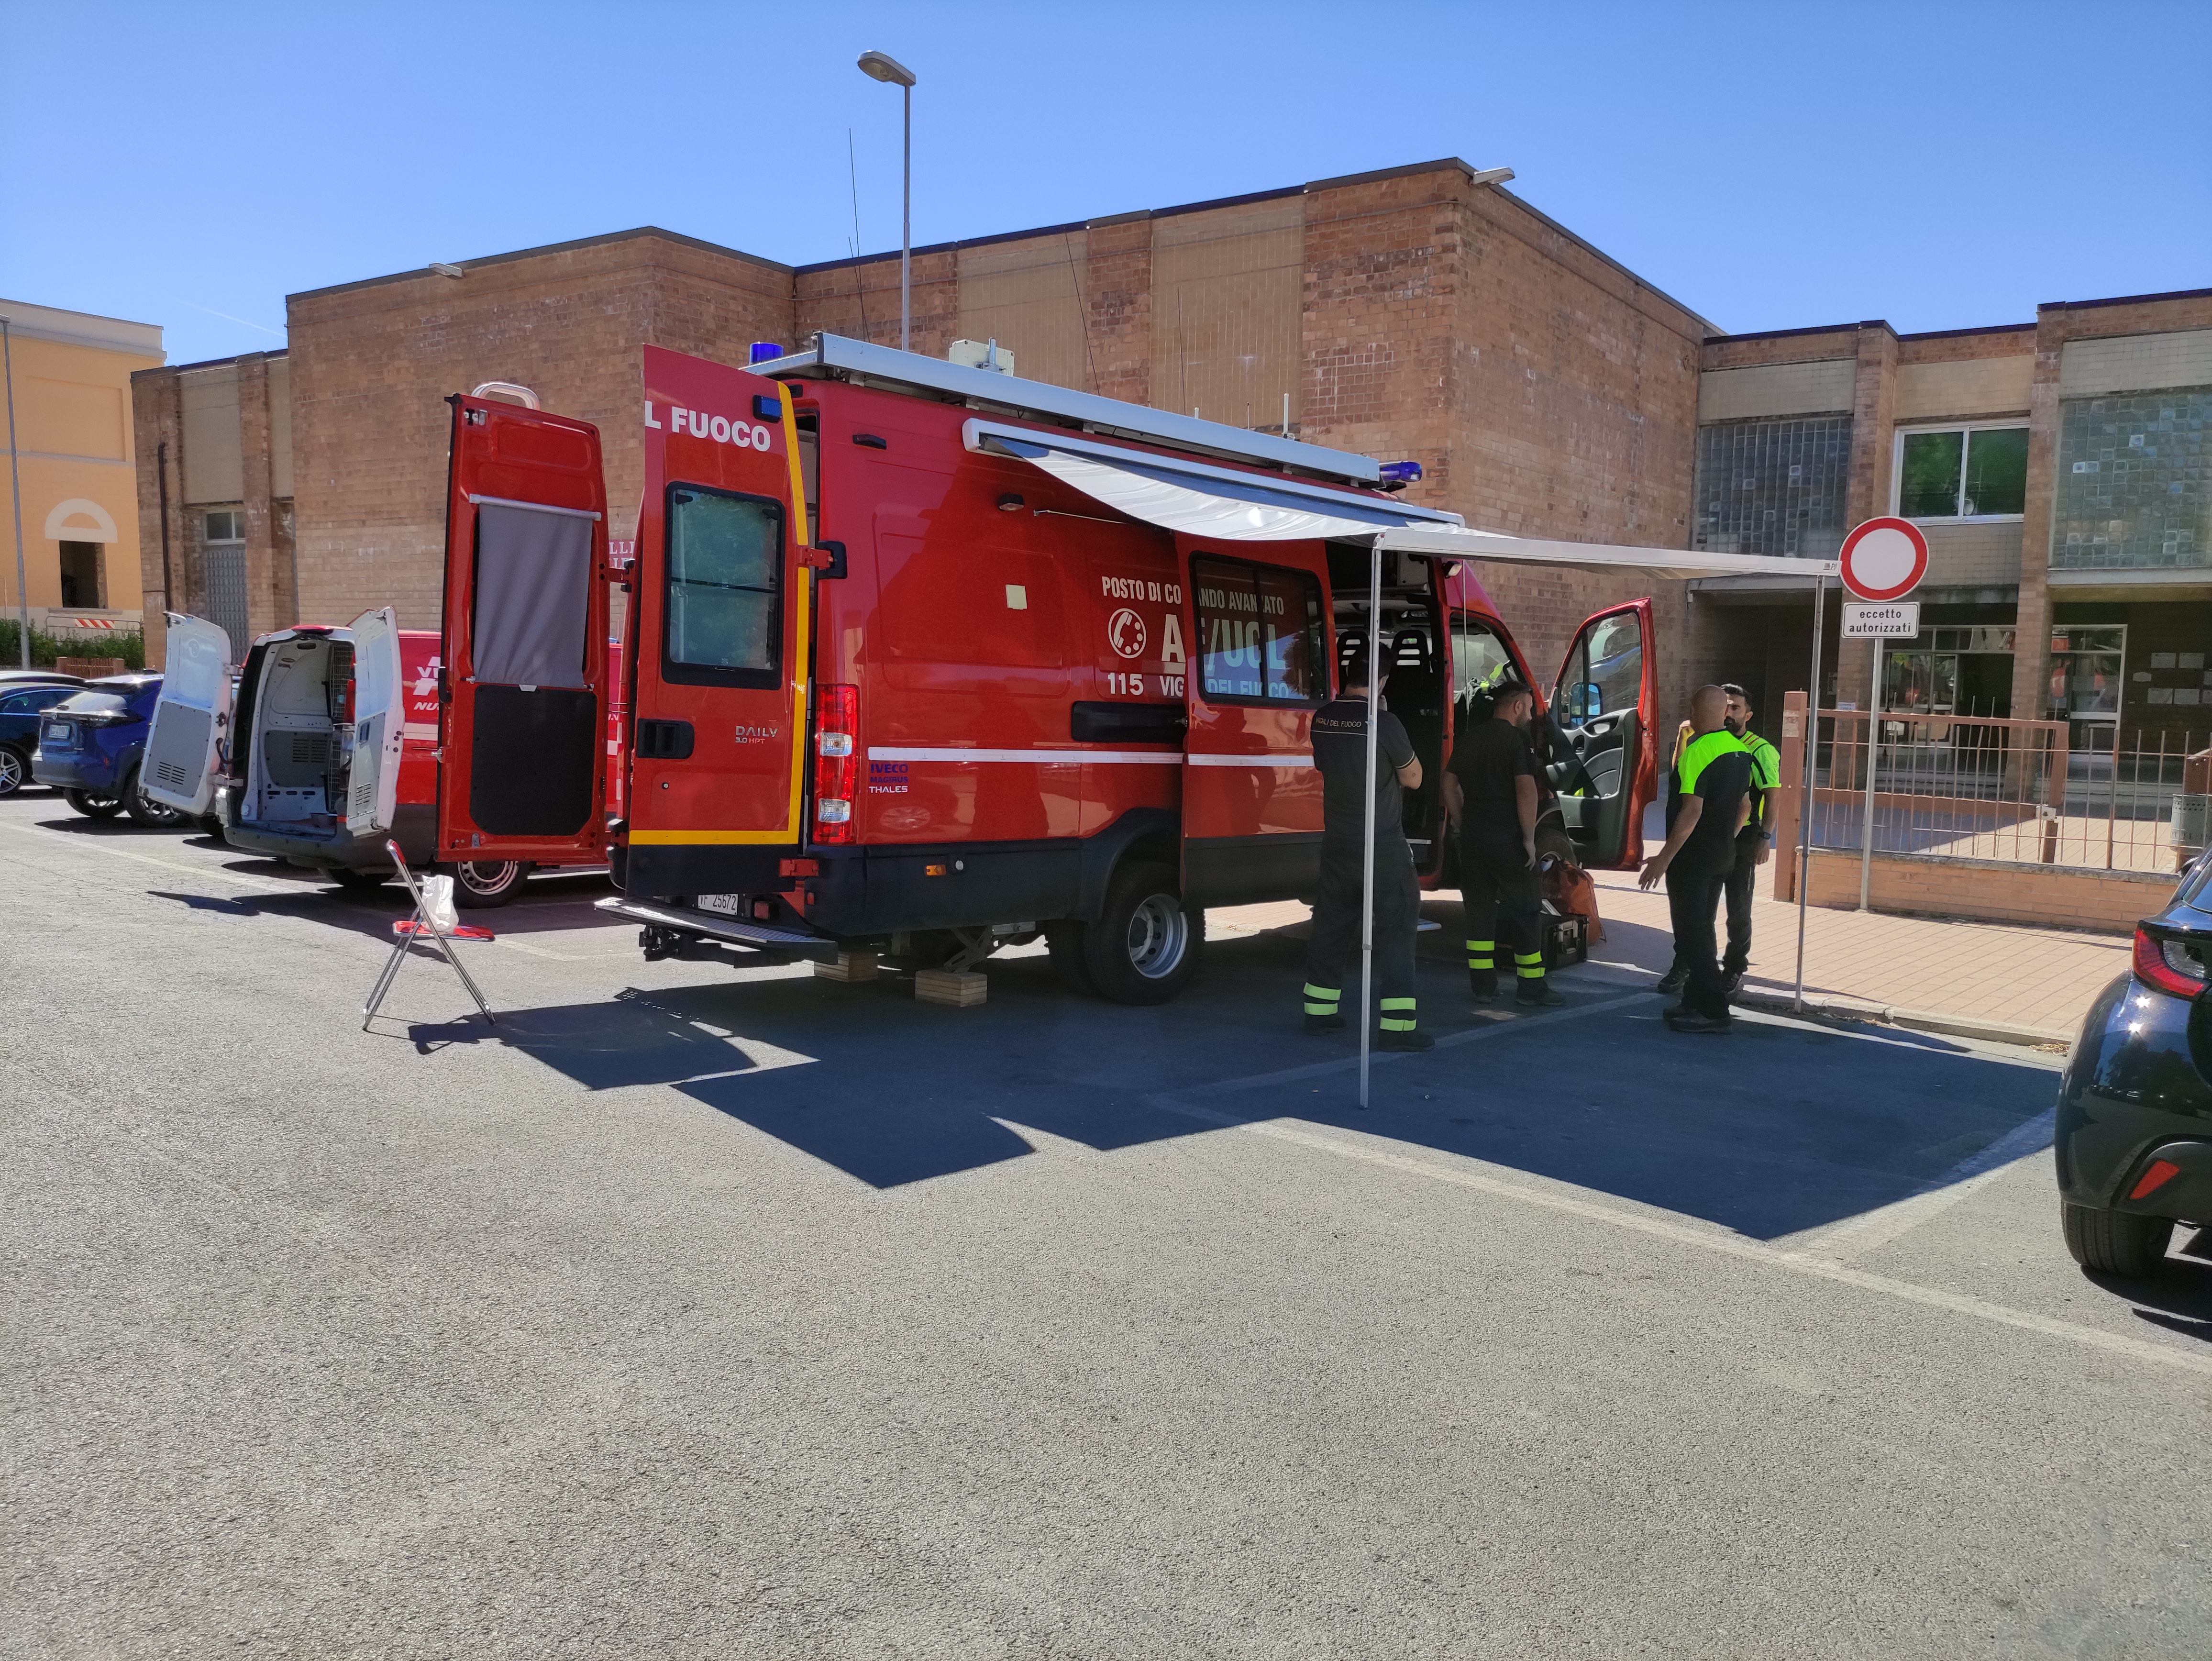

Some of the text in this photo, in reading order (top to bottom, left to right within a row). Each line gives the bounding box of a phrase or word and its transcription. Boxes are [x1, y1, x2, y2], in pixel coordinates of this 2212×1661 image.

[672, 406, 771, 452] FUOCO
[1101, 576, 1145, 600] POSTO
[1148, 581, 1161, 602] DI
[1229, 591, 1284, 615] AVANATO
[1859, 609, 1902, 619] eccetto
[1849, 622, 1911, 632] autorizzati
[1107, 672, 1144, 696] 115
[736, 726, 778, 737] DAILY
[871, 764, 908, 773] IVECO
[713, 894, 736, 911] 25672
